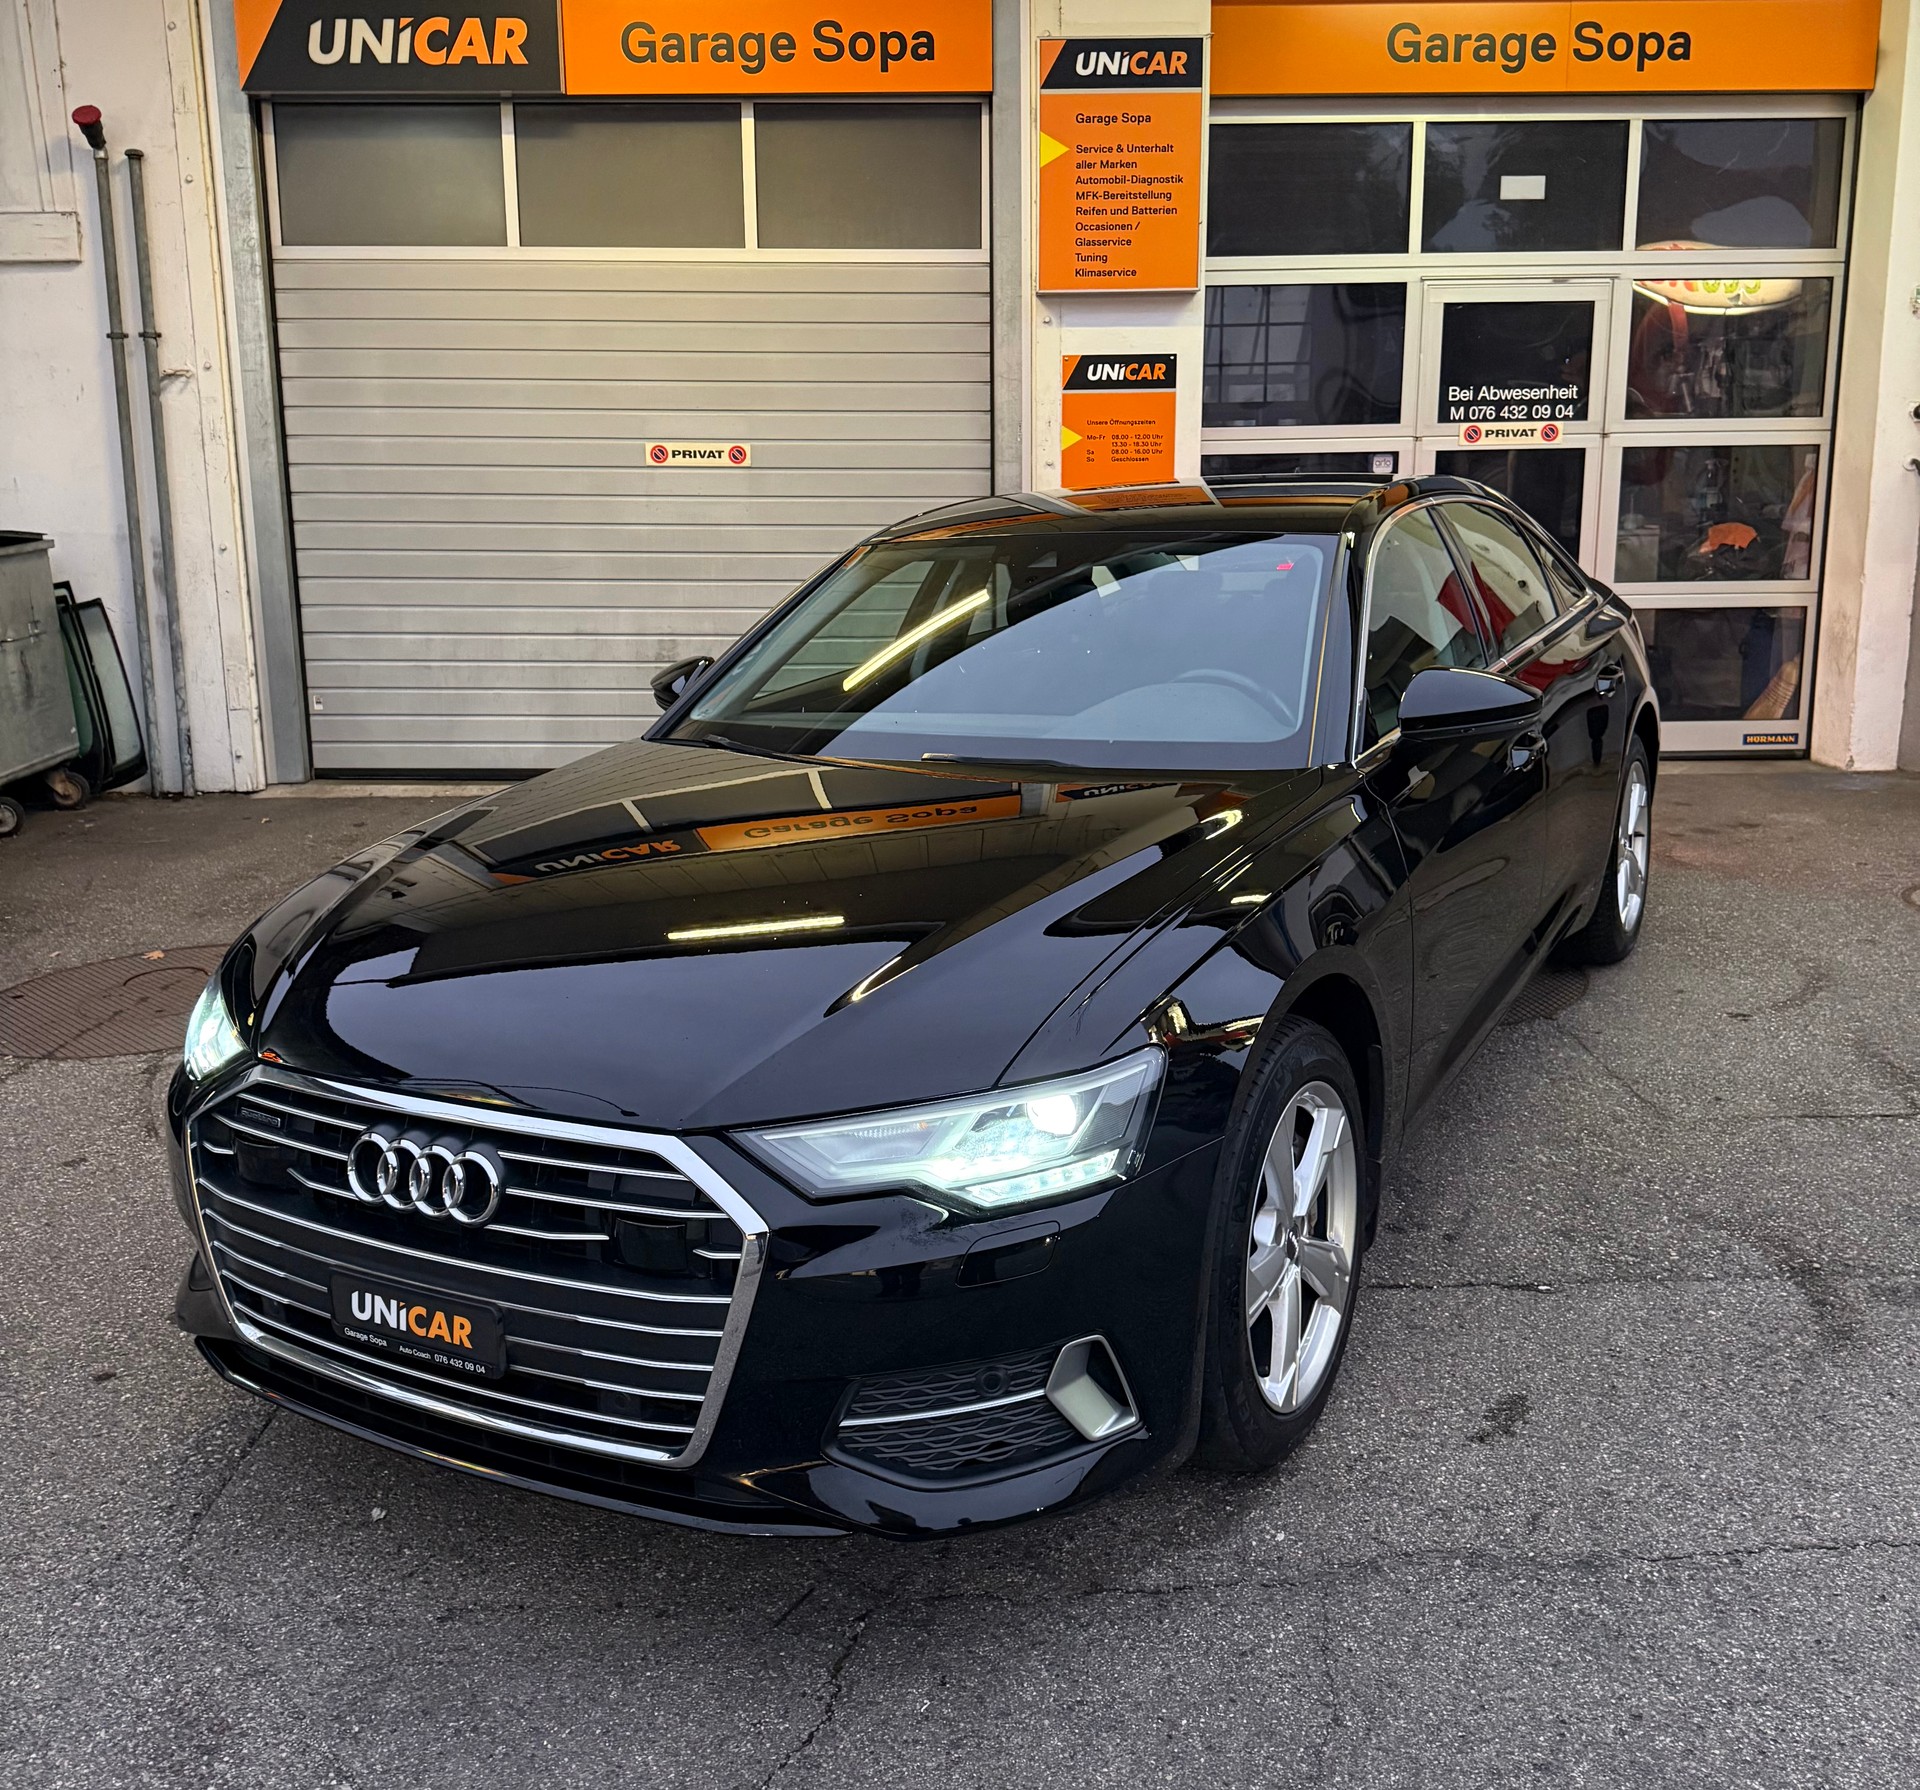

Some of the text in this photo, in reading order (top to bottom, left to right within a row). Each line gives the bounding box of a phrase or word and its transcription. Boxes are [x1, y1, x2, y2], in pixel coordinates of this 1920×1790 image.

[620, 20, 935, 75] Garage Sopa
[1386, 20, 1692, 74] Garage Sopa
[1076, 112, 1152, 126] Garage Sopa
[1076, 144, 1174, 154] Service & Unterhalt
[1076, 160, 1138, 170] aller Marken
[1076, 174, 1184, 186] Automobil-Diagnostik
[1076, 190, 1172, 202] MFK-Bereitstellung
[1076, 206, 1178, 216] Reifen und Batterien
[1076, 222, 1141, 231] Occasionen /
[1075, 237, 1132, 246] Glasservice
[1075, 252, 1108, 264] Tuning
[1075, 268, 1137, 278] Klimaservice
[1448, 384, 1578, 402] Bei Abwesenheit
[1450, 404, 1574, 420] M 076 432 09 04
[1109, 418, 1156, 426] Öffnungszeiten
[1484, 428, 1538, 438] PRIVAT
[671, 450, 724, 459] PRIVAT
[344, 1327, 485, 1374] Garage Sopa Auto Coach 076 432 09 04
